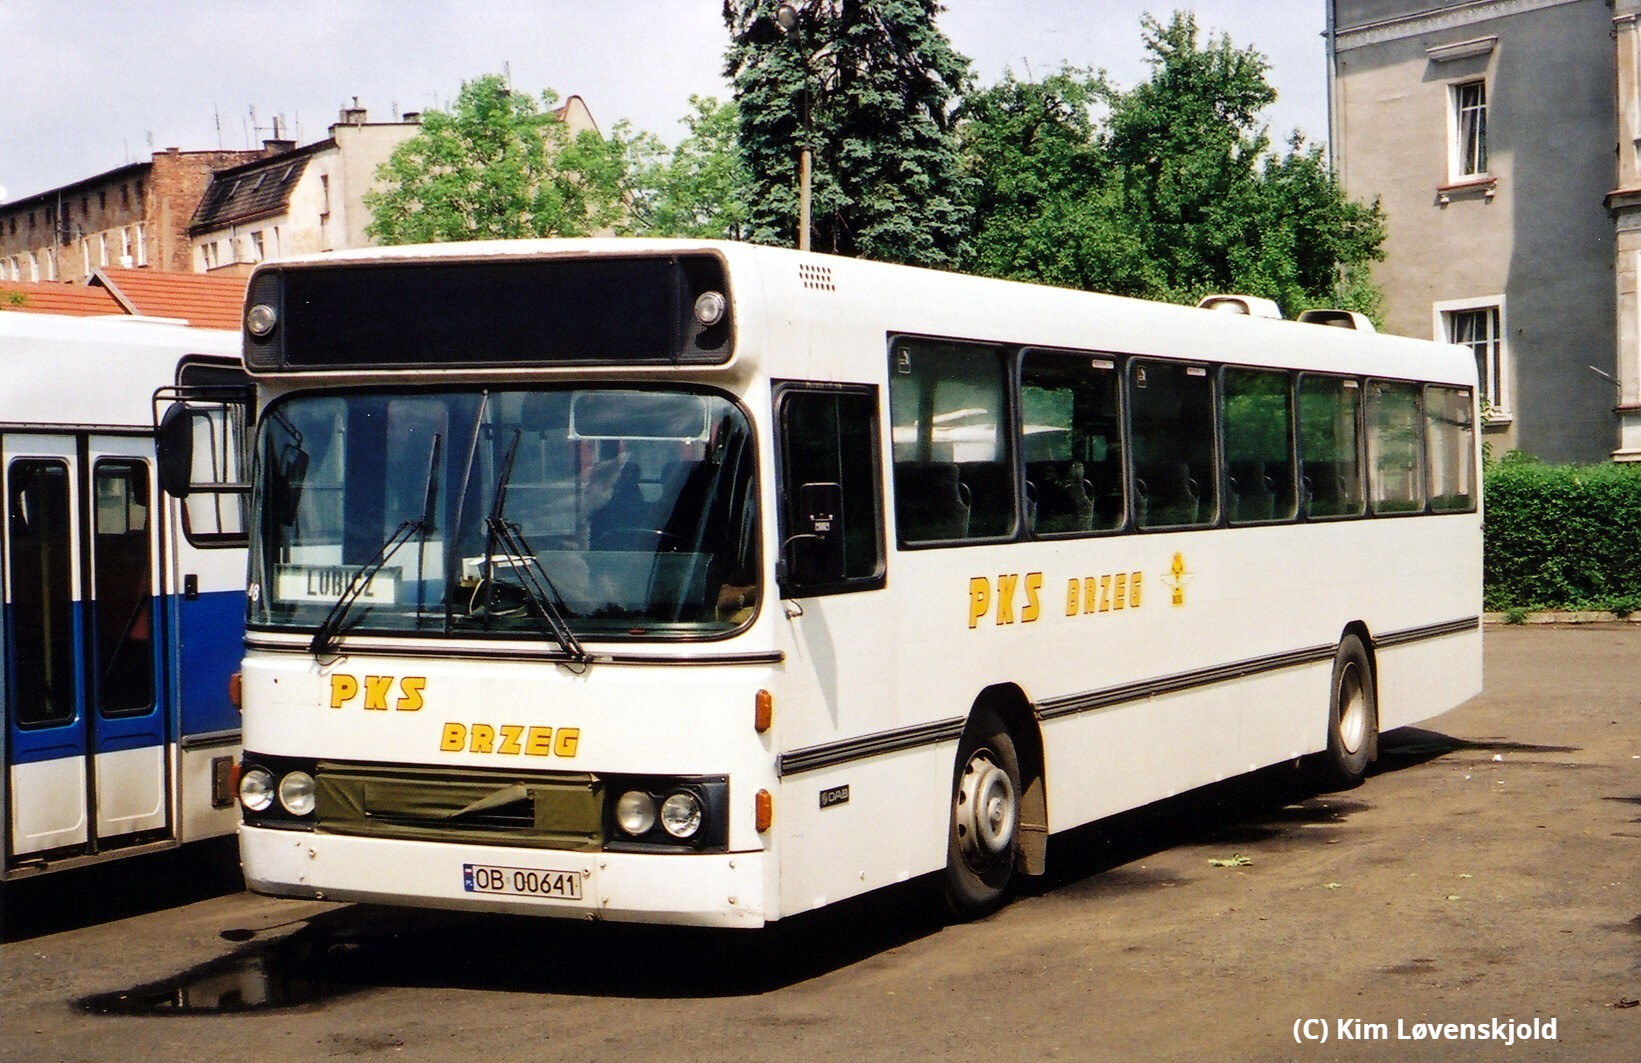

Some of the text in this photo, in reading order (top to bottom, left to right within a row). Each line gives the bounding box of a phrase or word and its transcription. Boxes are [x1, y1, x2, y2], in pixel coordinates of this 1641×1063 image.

[969, 571, 1142, 629] PKS BRZEG
[330, 674, 427, 712] PKS
[440, 722, 580, 758] BRZEG
[476, 868, 575, 896] OB 00641
